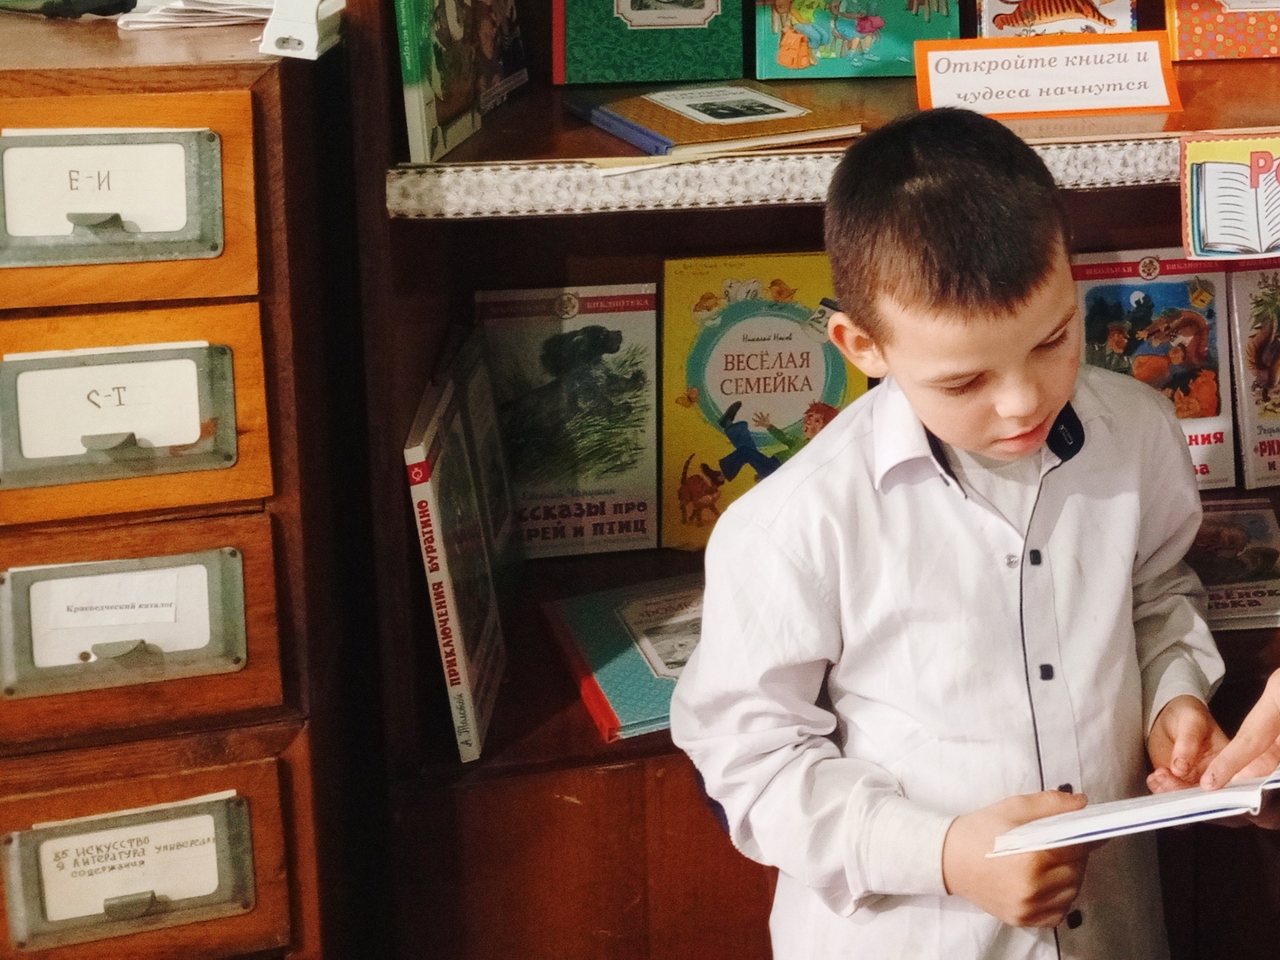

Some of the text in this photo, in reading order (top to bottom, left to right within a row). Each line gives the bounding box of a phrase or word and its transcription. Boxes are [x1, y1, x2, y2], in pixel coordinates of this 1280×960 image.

[934, 51, 1149, 76] Откройте книги и
[956, 78, 1149, 103] чудеса начнутся
[724, 351, 810, 371] ВЕСЁЛАЯ
[720, 373, 813, 396] СЕМЕЙКА
[67, 603, 136, 613] Краеведческий
[432, 581, 462, 687] ПРИКЛЮЧЕНИЯ
[75, 836, 150, 857] ИСКУССТВО
